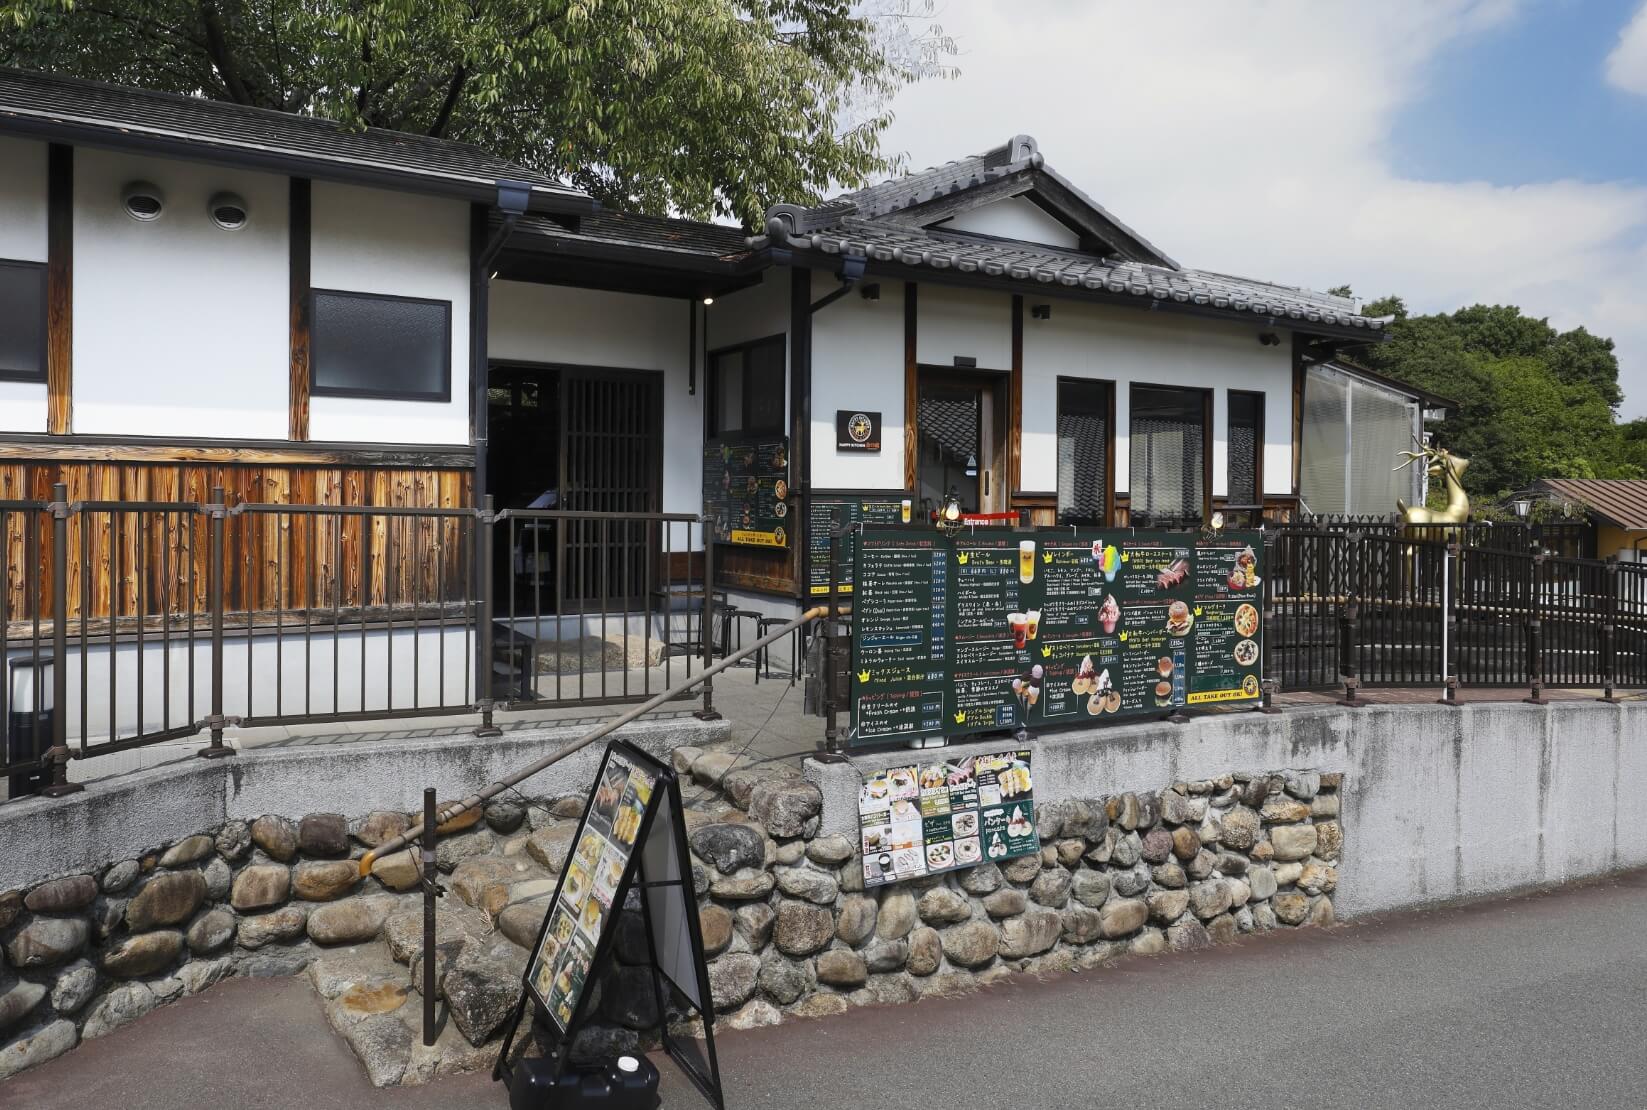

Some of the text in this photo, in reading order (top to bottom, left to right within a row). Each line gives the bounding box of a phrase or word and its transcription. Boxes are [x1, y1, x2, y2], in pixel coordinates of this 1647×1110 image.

[964, 518, 989, 526] Entrance
[970, 551, 991, 559] 生ビール
[871, 667, 911, 676] ミックスジュース
